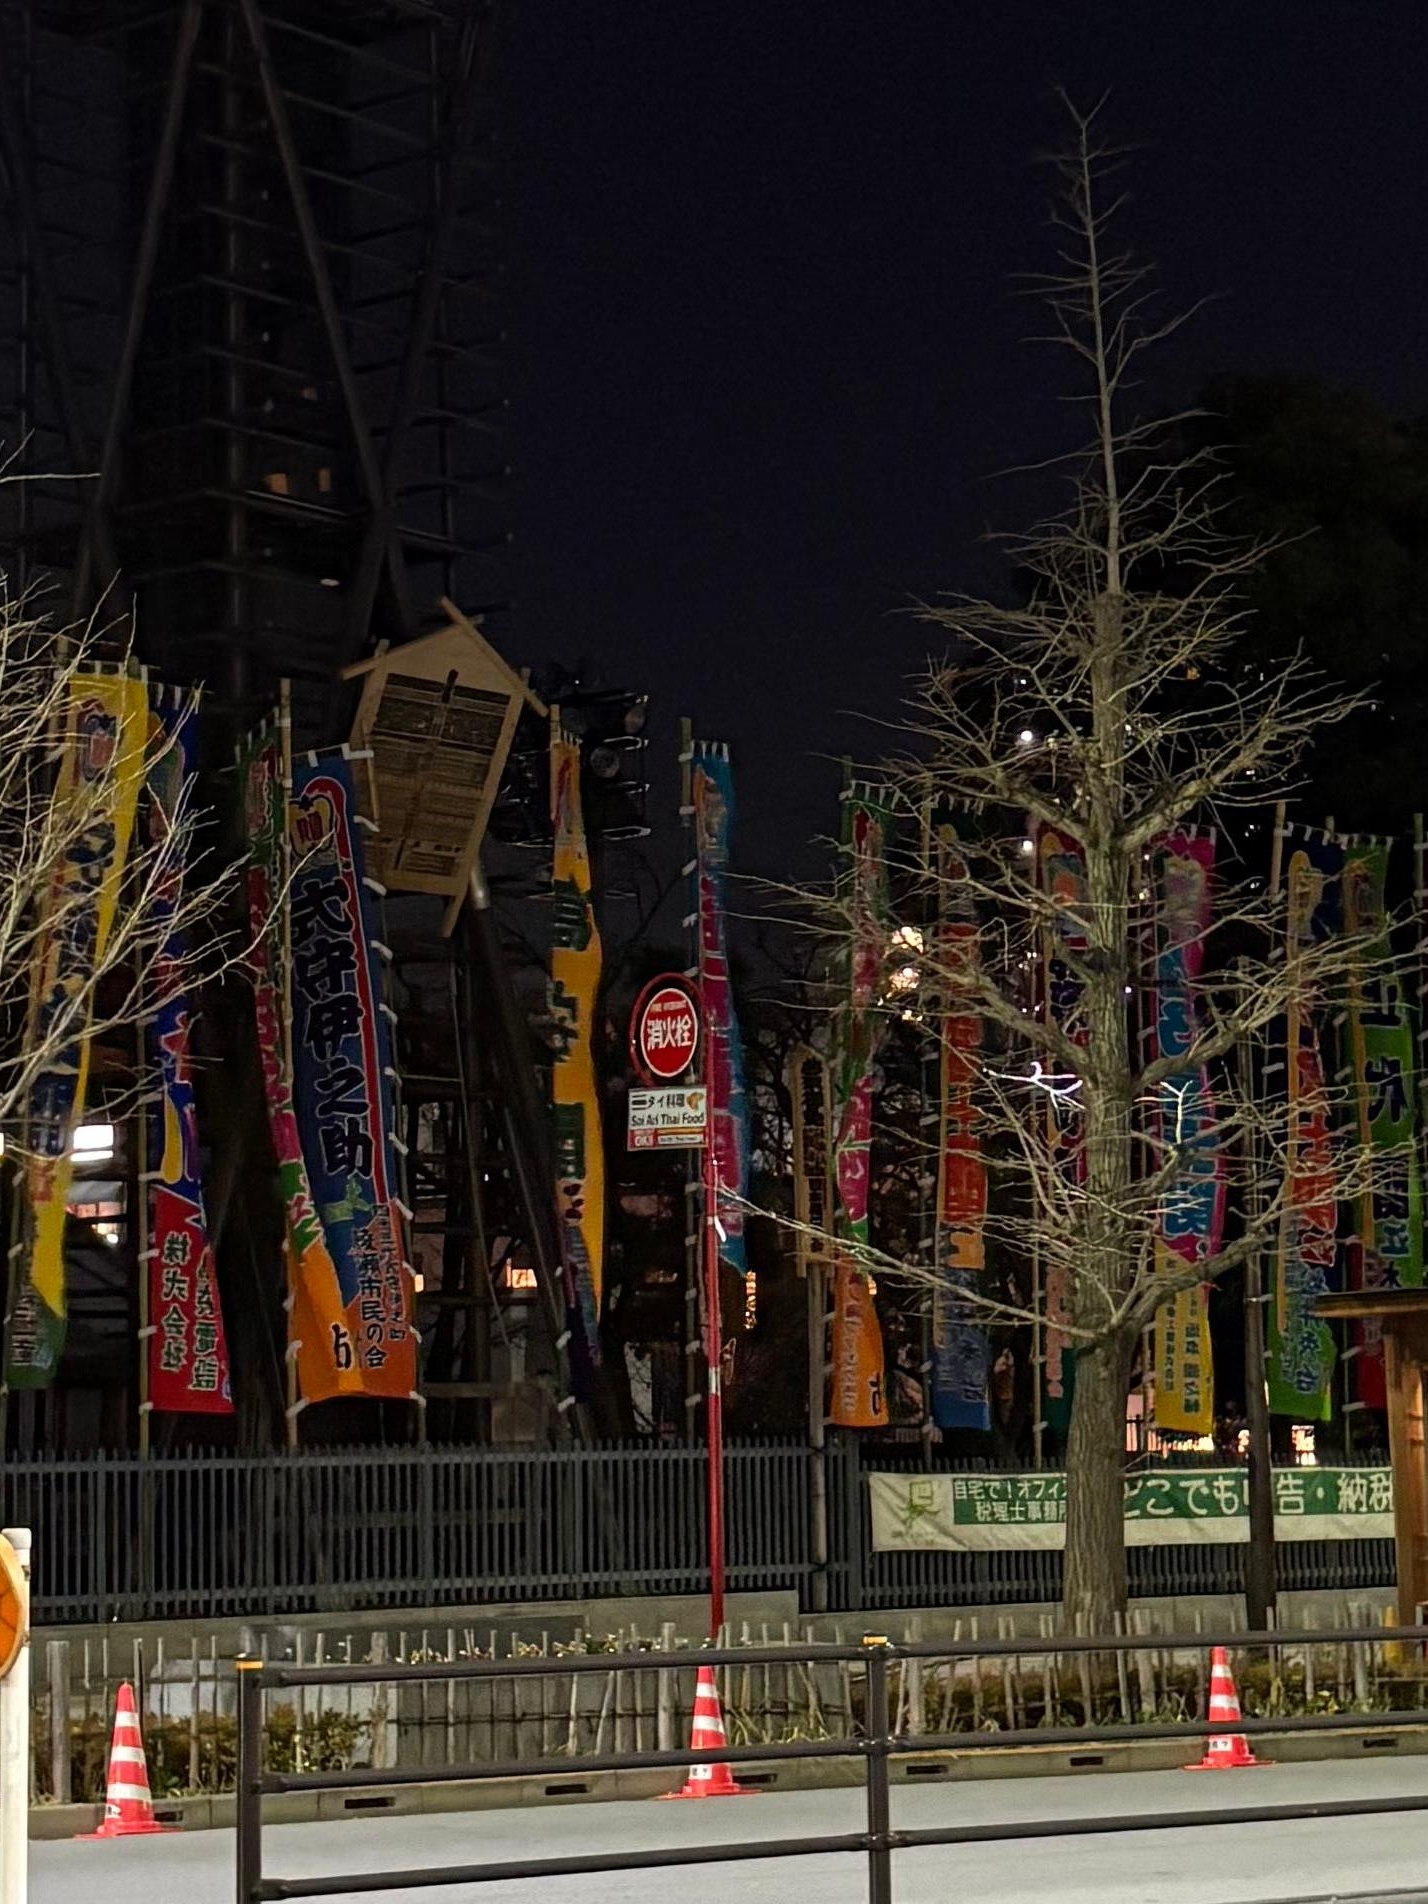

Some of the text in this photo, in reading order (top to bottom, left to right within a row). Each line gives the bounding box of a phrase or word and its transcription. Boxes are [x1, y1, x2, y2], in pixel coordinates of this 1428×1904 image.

[646, 1014, 693, 1052] 消火栓
[661, 1113, 681, 1125] Thai
[682, 1111, 704, 1125] Food
